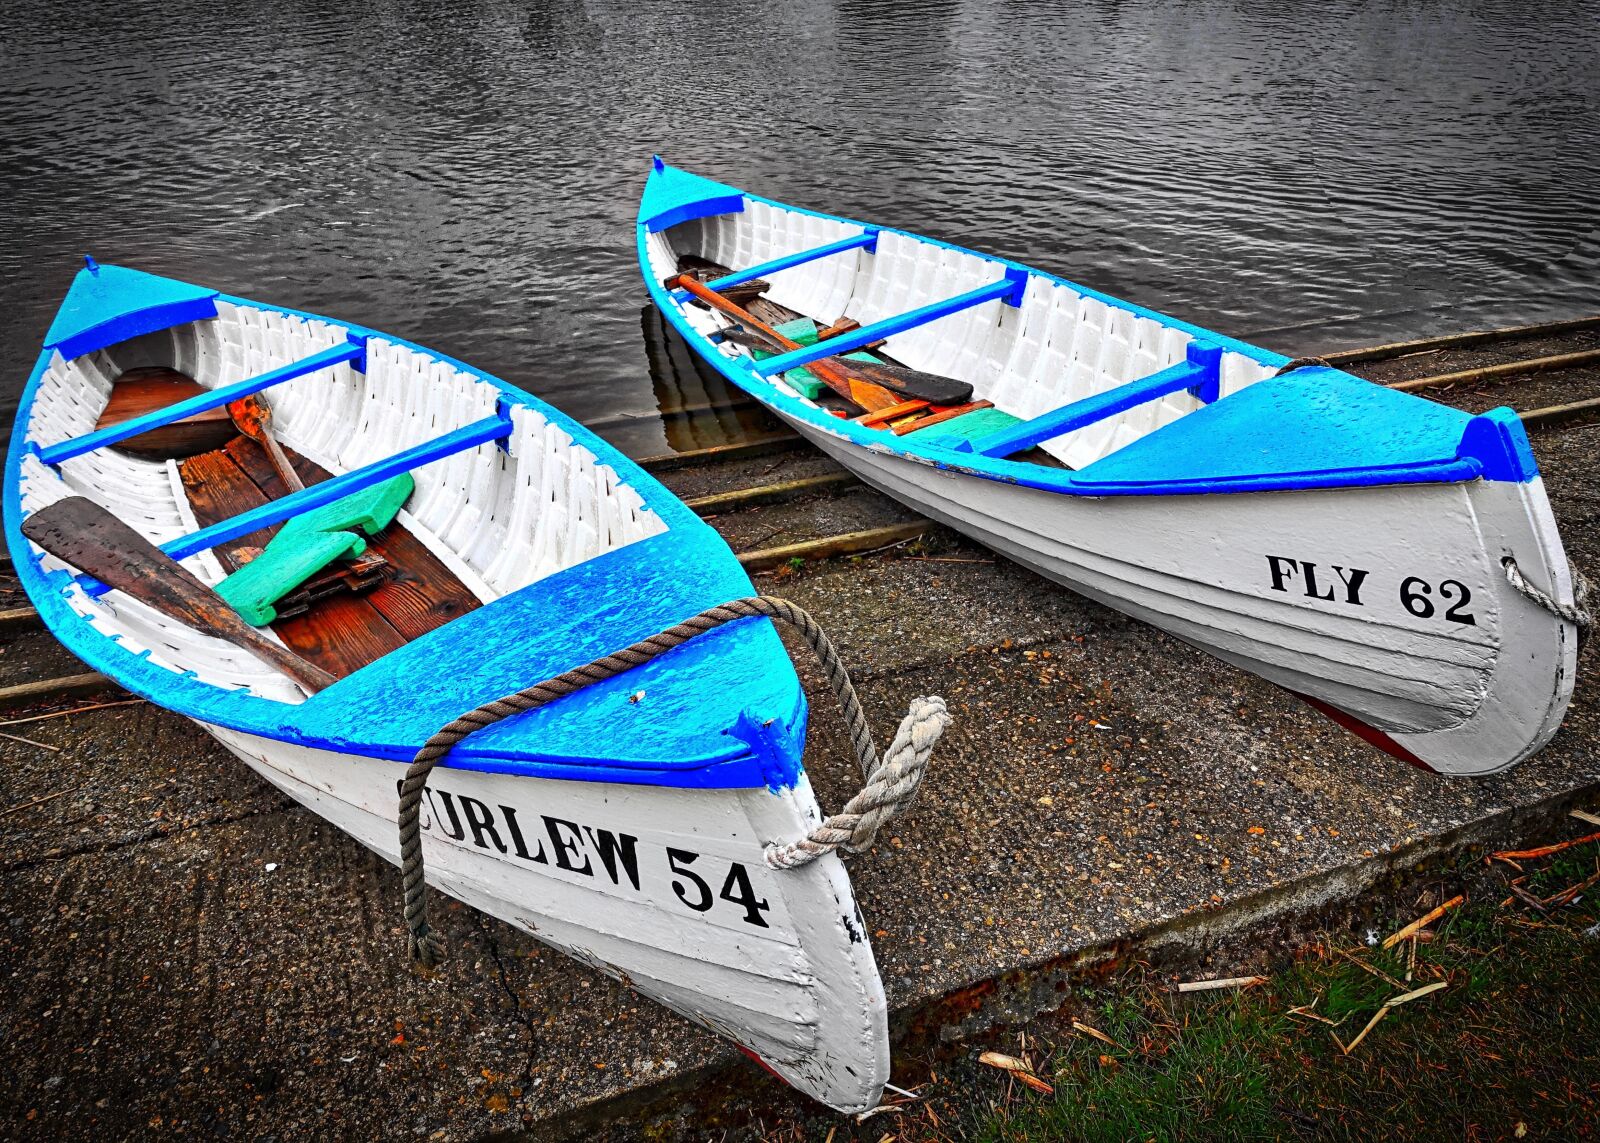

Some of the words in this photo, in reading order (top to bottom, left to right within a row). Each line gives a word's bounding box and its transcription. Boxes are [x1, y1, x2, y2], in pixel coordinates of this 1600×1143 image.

[1265, 555, 1370, 606] FLY
[1399, 576, 1477, 626] 62
[666, 846, 770, 929] 54
